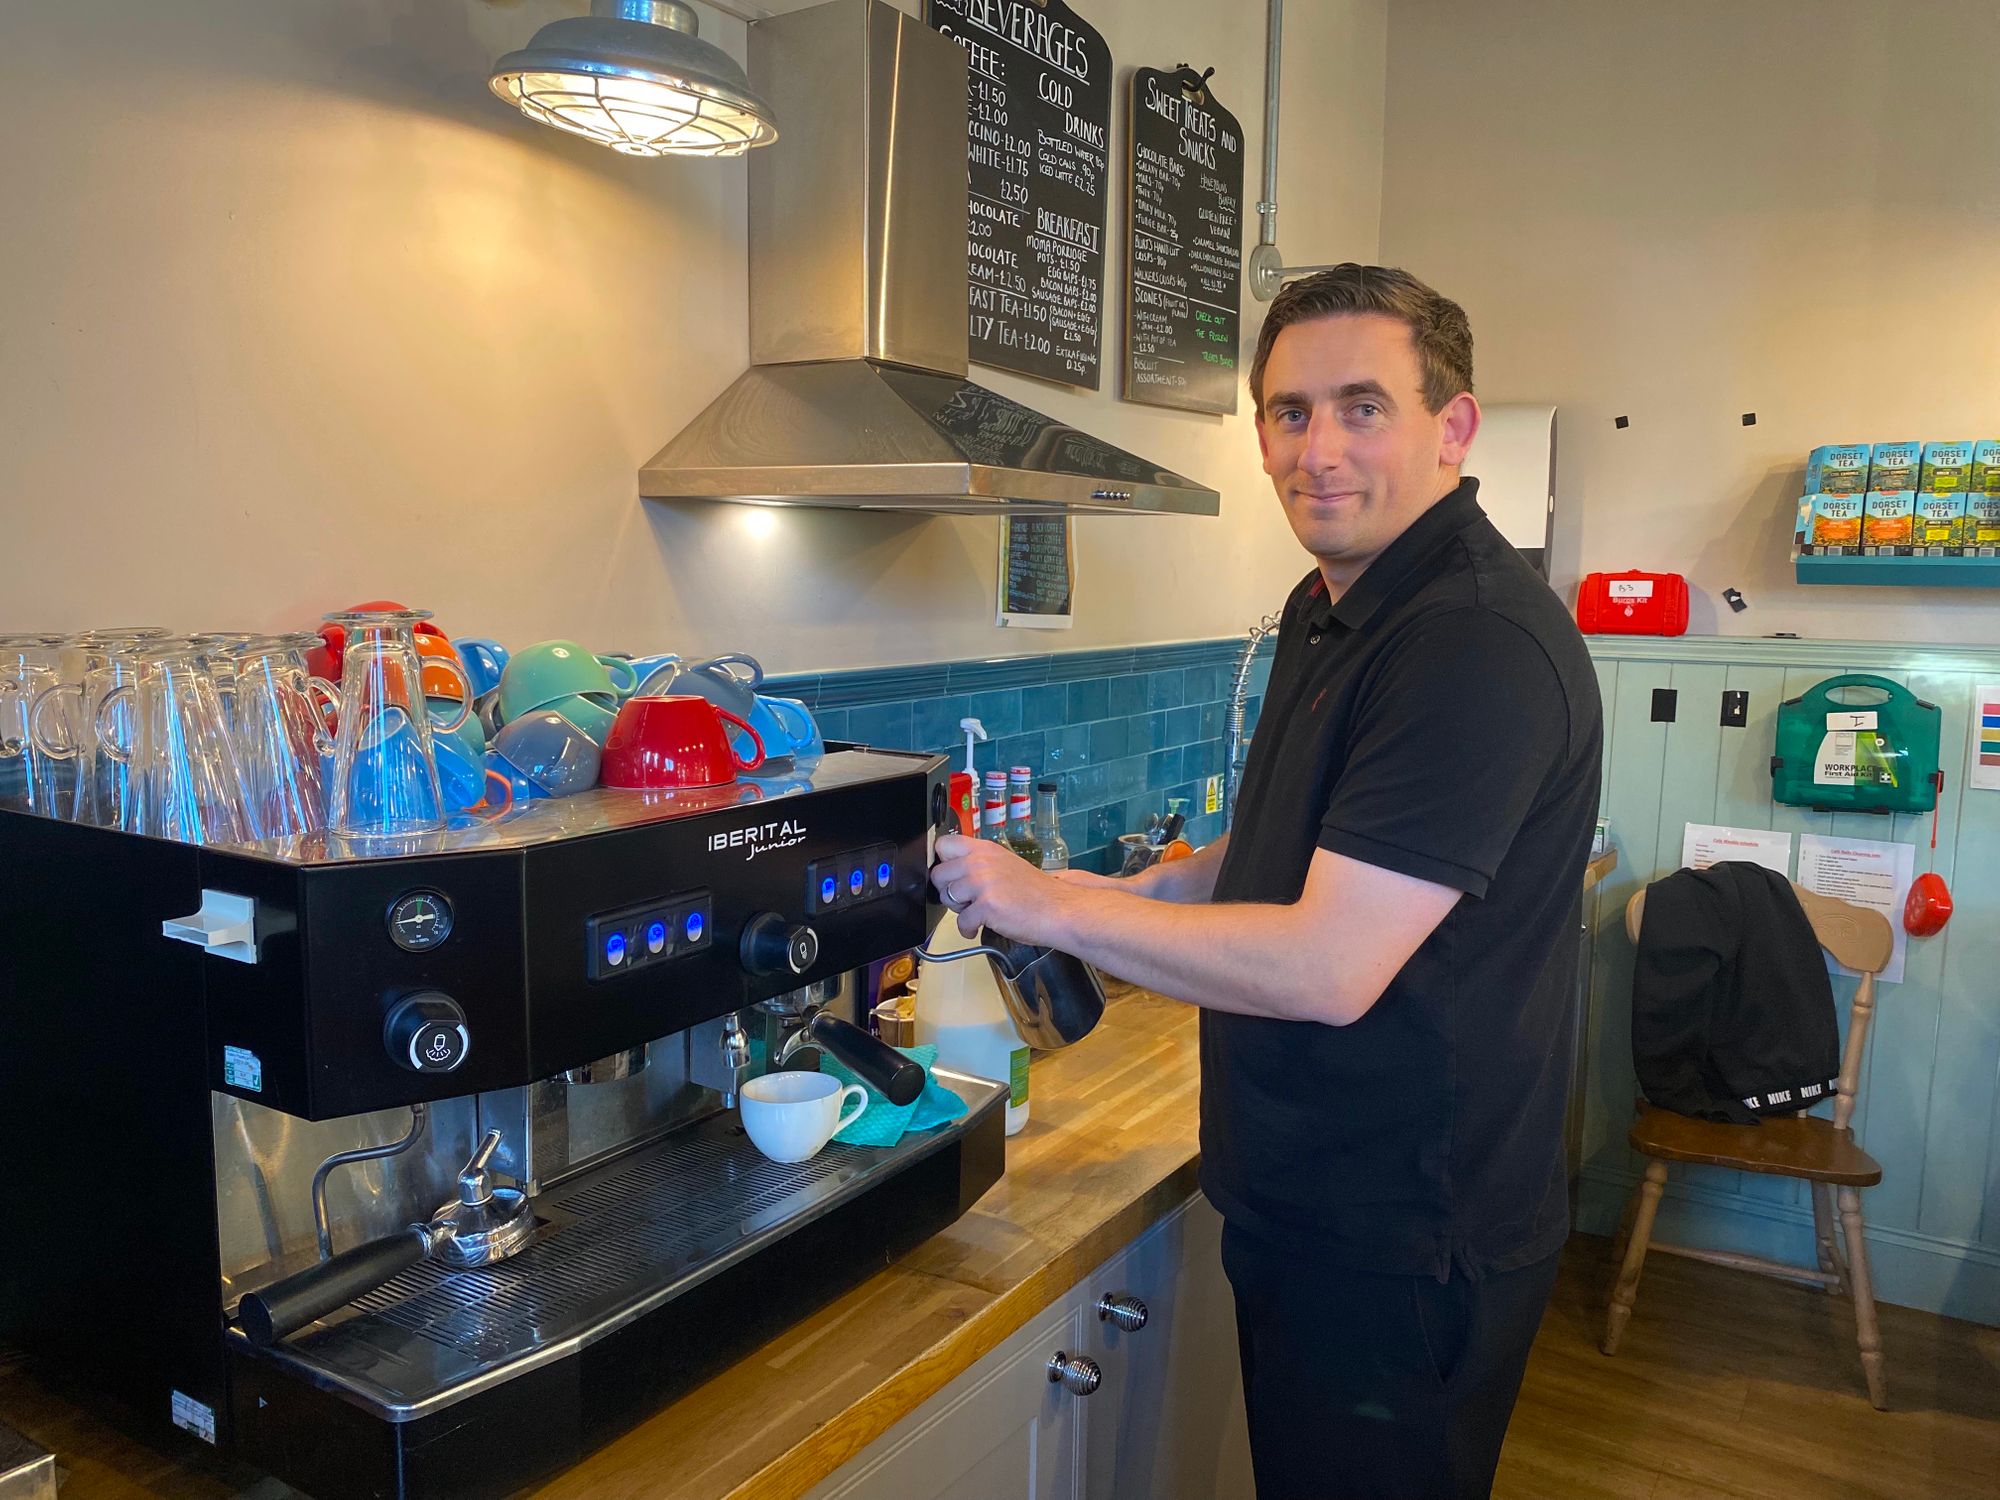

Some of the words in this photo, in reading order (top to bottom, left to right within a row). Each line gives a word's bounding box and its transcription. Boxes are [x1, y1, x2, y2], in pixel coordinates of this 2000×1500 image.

[969, 0, 1088, 79] BEVERAGES
[1038, 72, 1073, 108] COLD
[1145, 77, 1181, 124] SWEET
[1181, 94, 1216, 142] TREATS
[1221, 130, 1237, 153] AND
[1065, 111, 1104, 148] DRINKS
[1037, 128, 1073, 154] BOTTLED
[1074, 145, 1095, 168] WATER
[1136, 142, 1168, 169] CHOCOLATE
[1178, 126, 1216, 170] SNACKS
[1038, 148, 1057, 164] COLD
[1058, 157, 1076, 171] CANS
[1039, 163, 1054, 176] ICED
[1054, 168, 1074, 184] LATTE
[1037, 207, 1100, 251] BREAKFAST
[968, 240, 1019, 269] OCOLATE
[1026, 235, 1051, 253] MOMA
[1052, 240, 1088, 263] PORRIDGE
[1047, 265, 1062, 280] EGG
[1031, 285, 1063, 305] SAUSAGE
[1040, 276, 1064, 294] BACON
[969, 286, 997, 311] FAST
[1135, 286, 1162, 308] SCONES
[970, 314, 994, 340] LTY
[1055, 345, 1076, 360] EXTRA
[1830, 452, 1864, 461] DORSET
[1879, 450, 1913, 459] DORSET
[1888, 458, 1904, 466] TEA
[1931, 450, 1967, 458] DORSET
[1941, 457, 1957, 465] TEA
[1823, 502, 1857, 510] DORSET
[1831, 509, 1848, 517] TEA
[1872, 500, 1907, 509] DORSET
[1881, 508, 1898, 516] TEA
[1923, 502, 1959, 510] DORSET
[1932, 509, 1949, 517] TEA
[707, 819, 807, 852] IBERITAL
[746, 835, 807, 861] Junior
[1767, 1090, 1792, 1105] NIKE
